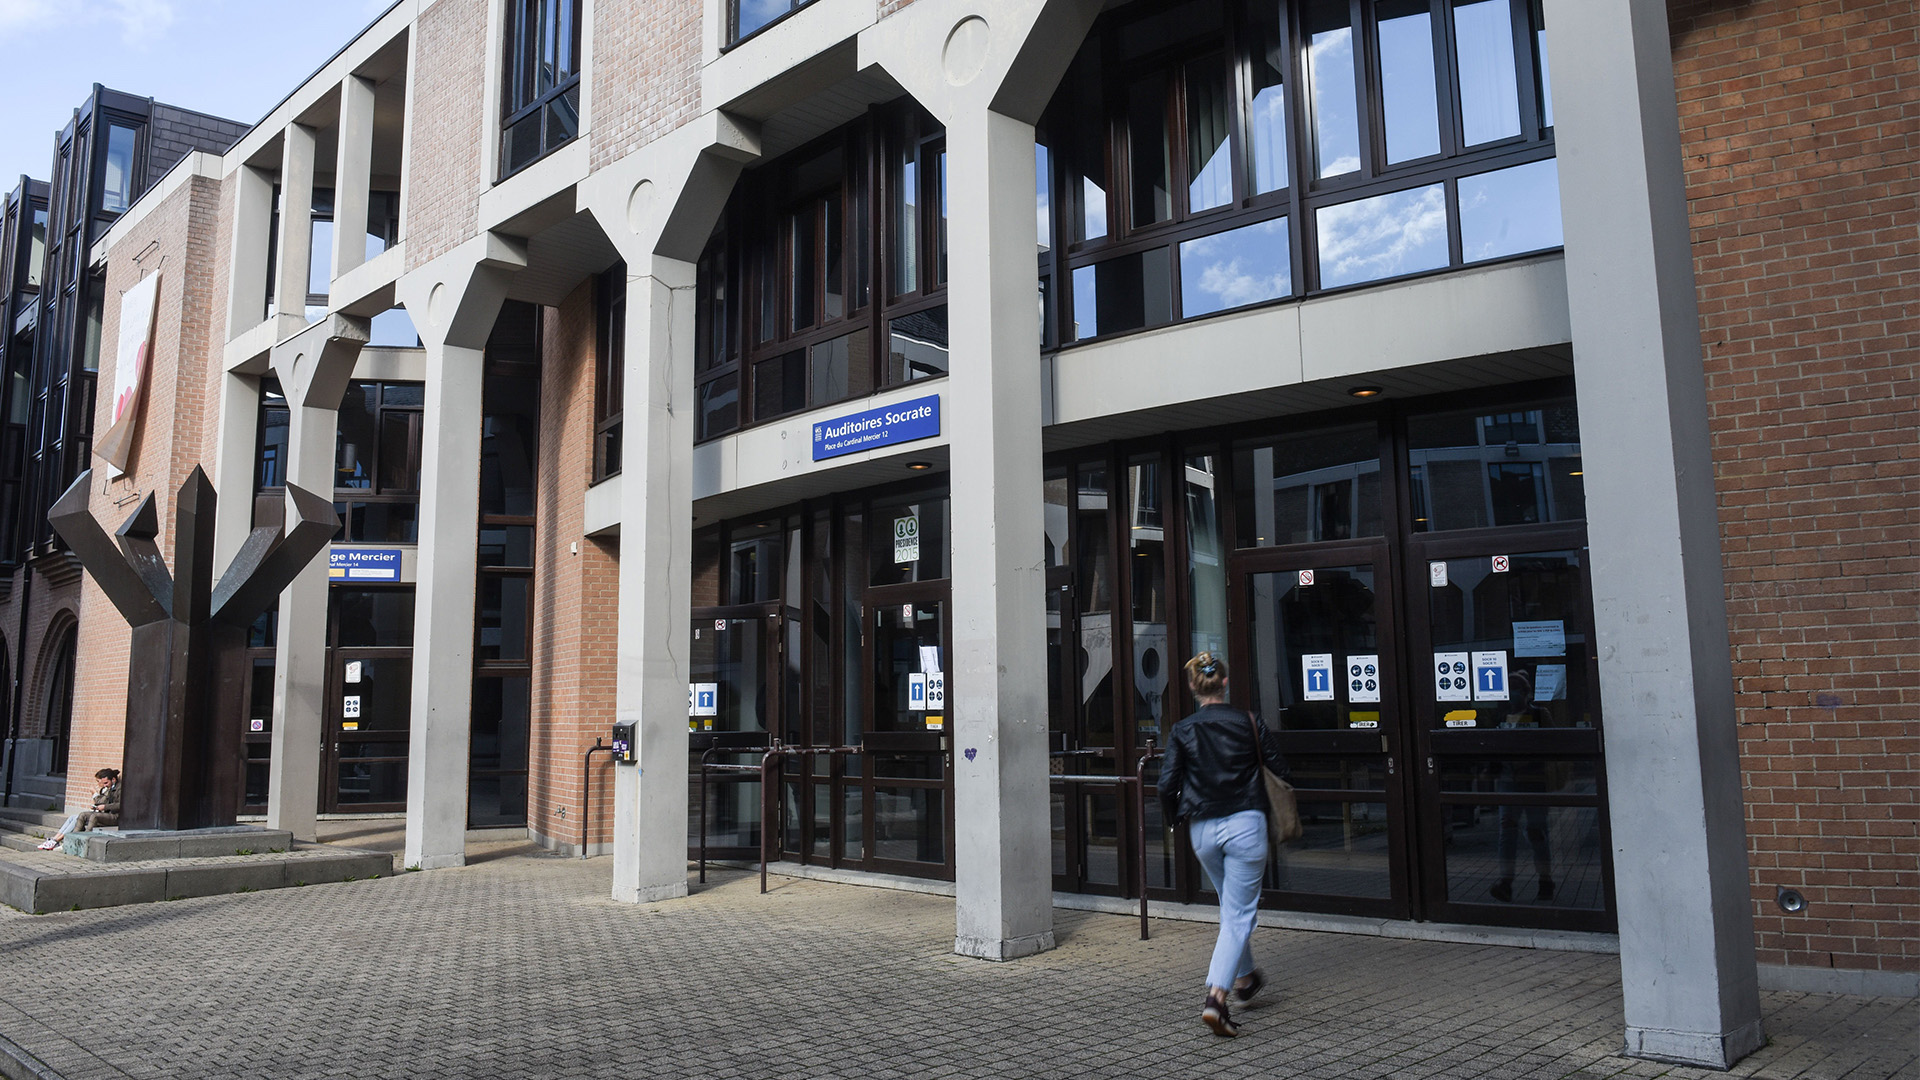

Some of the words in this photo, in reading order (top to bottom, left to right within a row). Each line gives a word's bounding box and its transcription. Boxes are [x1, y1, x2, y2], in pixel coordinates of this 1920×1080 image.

[825, 418, 882, 440] Auditoires
[885, 406, 932, 426] Socrate
[825, 443, 836, 452] Place
[844, 437, 863, 447] Cardinal
[863, 433, 881, 443] Mercier
[882, 430, 889, 438] 12
[349, 553, 395, 561] Mercier
[896, 546, 918, 562] 2015
